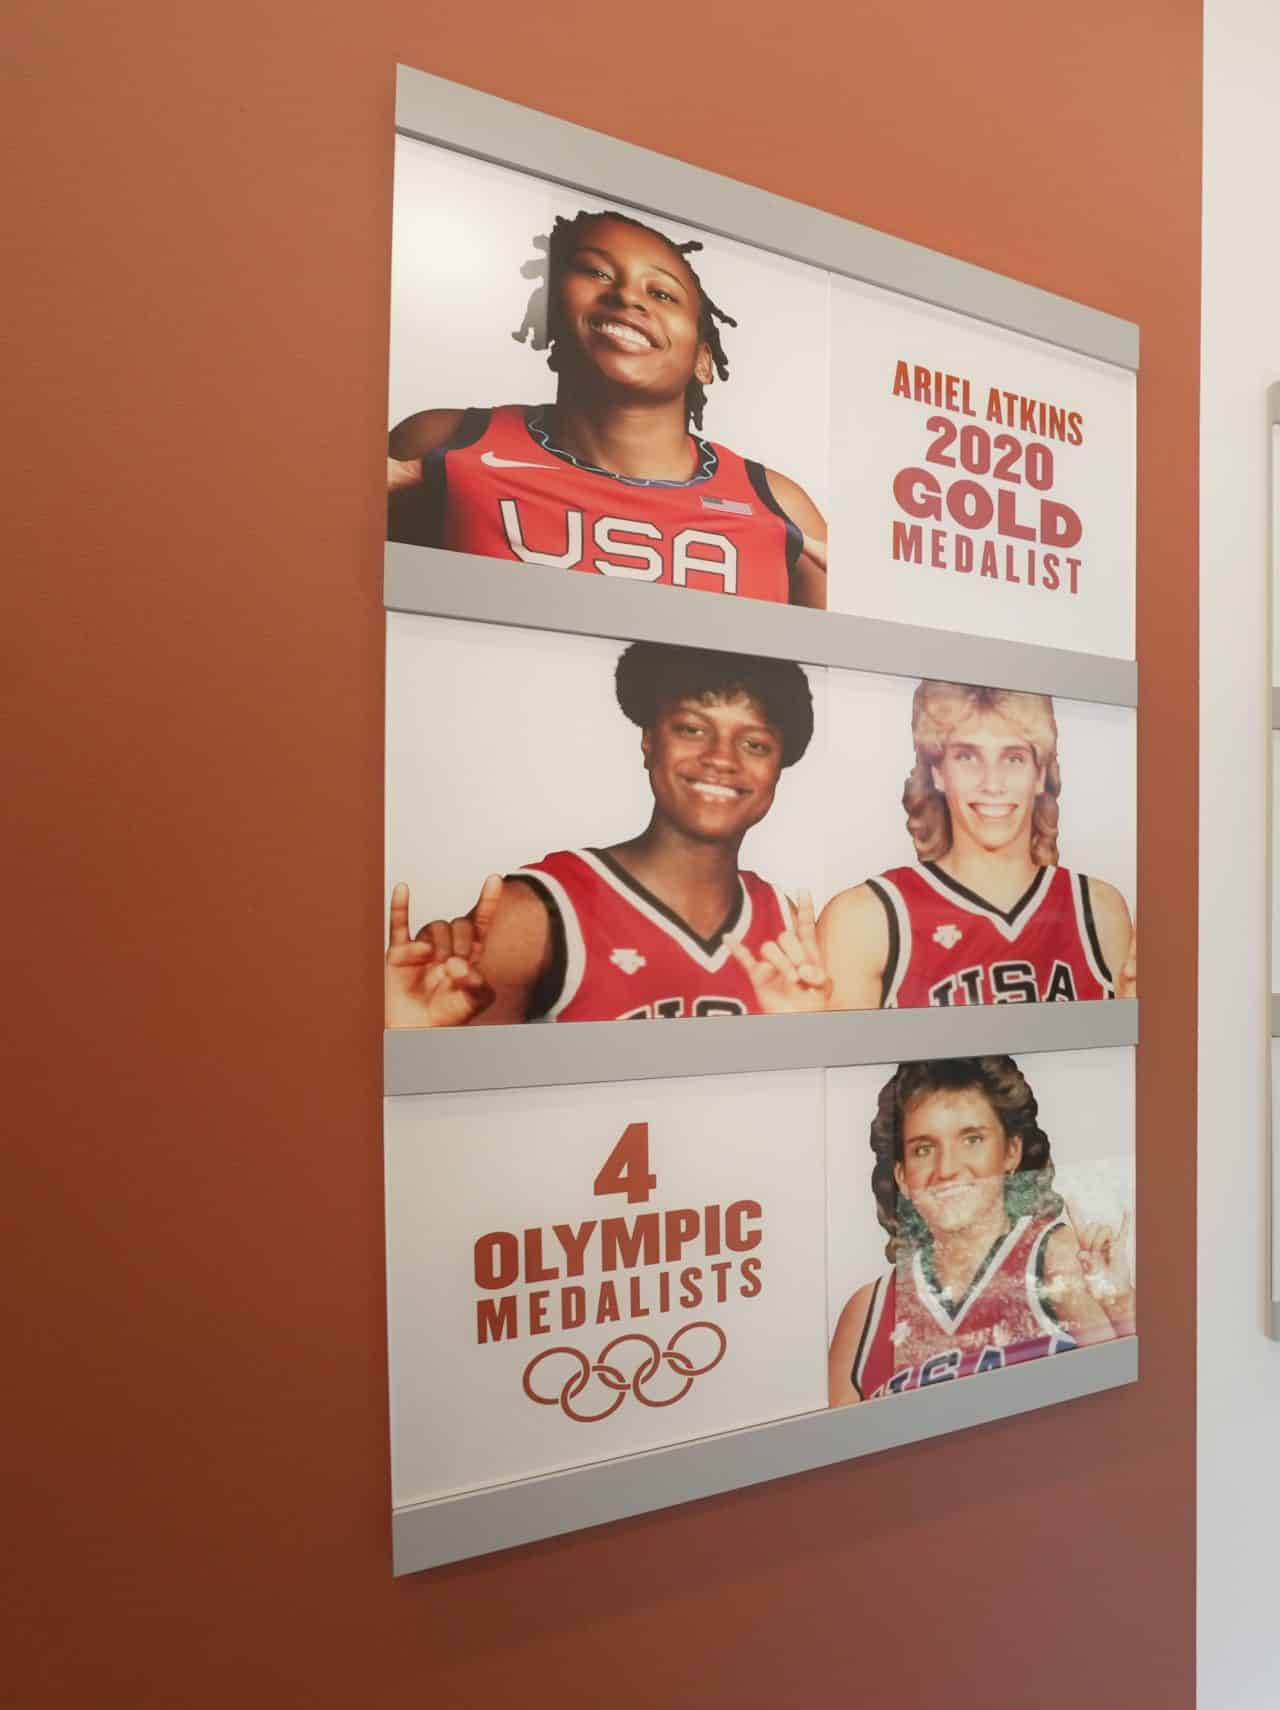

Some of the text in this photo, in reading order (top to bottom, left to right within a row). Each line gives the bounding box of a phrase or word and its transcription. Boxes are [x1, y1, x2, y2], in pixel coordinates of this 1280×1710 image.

[892, 360, 1083, 445] ARIEL ATKINS
[926, 415, 1054, 491] 2020
[498, 498, 738, 596] USA
[892, 467, 1083, 549] GOLD
[892, 521, 1082, 594] MEDALIST
[593, 1122, 657, 1203] 4
[474, 1200, 762, 1291] OLYMPIC
[476, 1258, 762, 1344] MEDALISTS
